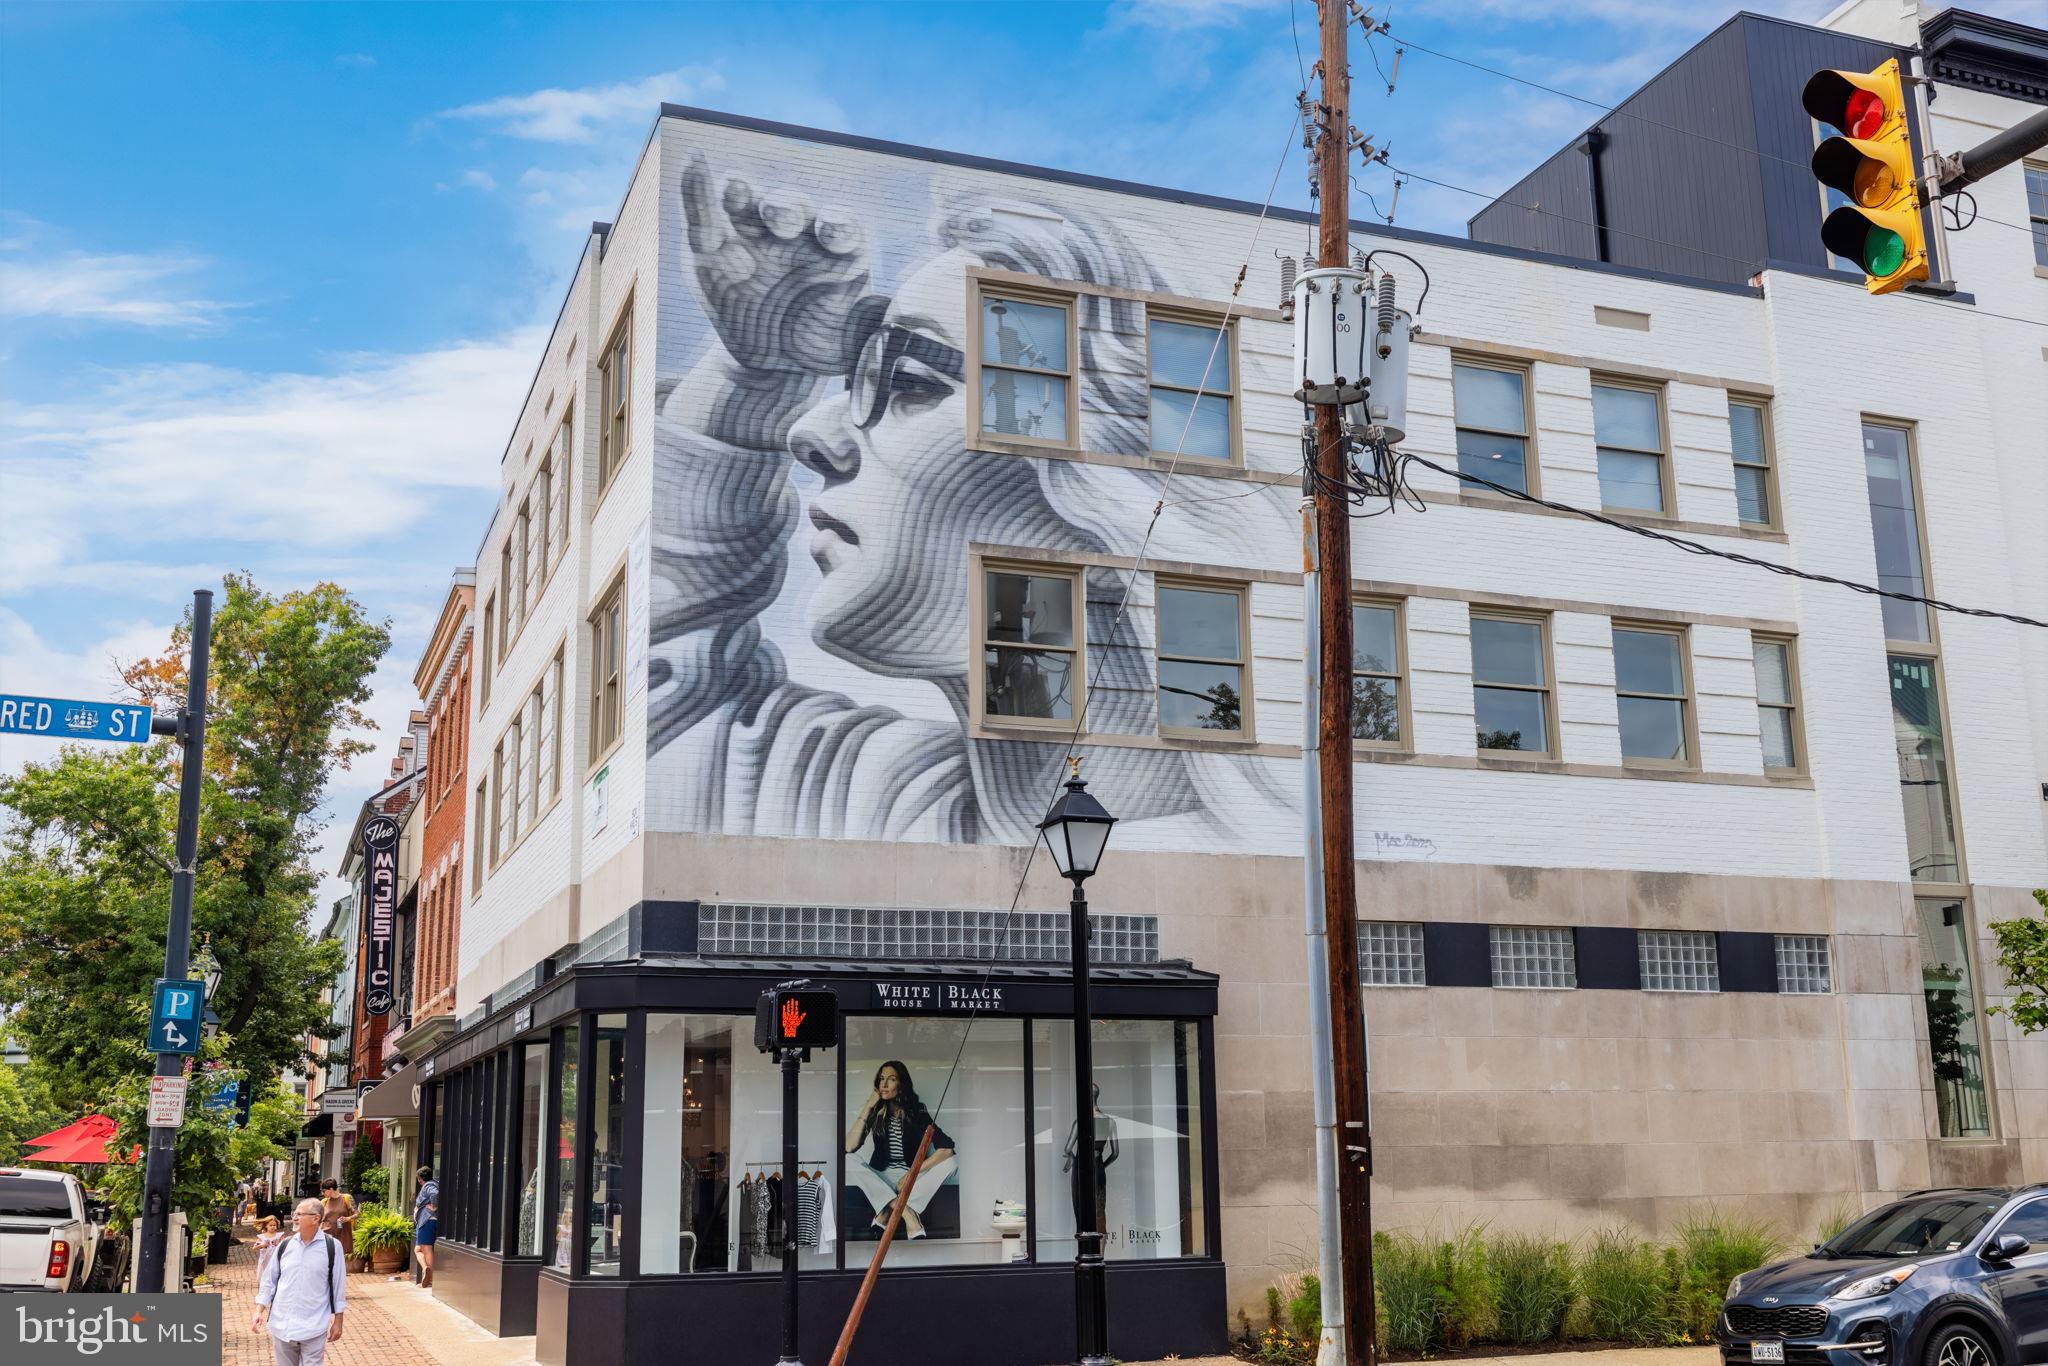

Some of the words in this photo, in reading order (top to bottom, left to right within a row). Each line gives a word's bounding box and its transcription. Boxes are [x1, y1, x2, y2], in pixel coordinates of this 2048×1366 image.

[0, 700, 53, 731] RED
[109, 709, 143, 737] ST
[366, 825, 395, 842] The
[371, 852, 394, 986] MAJESTIC
[367, 992, 390, 1008] Cafe
[876, 983, 931, 998] WHITE
[947, 985, 1003, 1000] BLACK
[167, 991, 190, 1017] P
[883, 999, 923, 1008] HOUSE
[950, 1000, 1000, 1009] MARKET
[152, 1079, 163, 1089] NO
[163, 1081, 185, 1089] PARKING
[1128, 1229, 1161, 1240] BLACK
